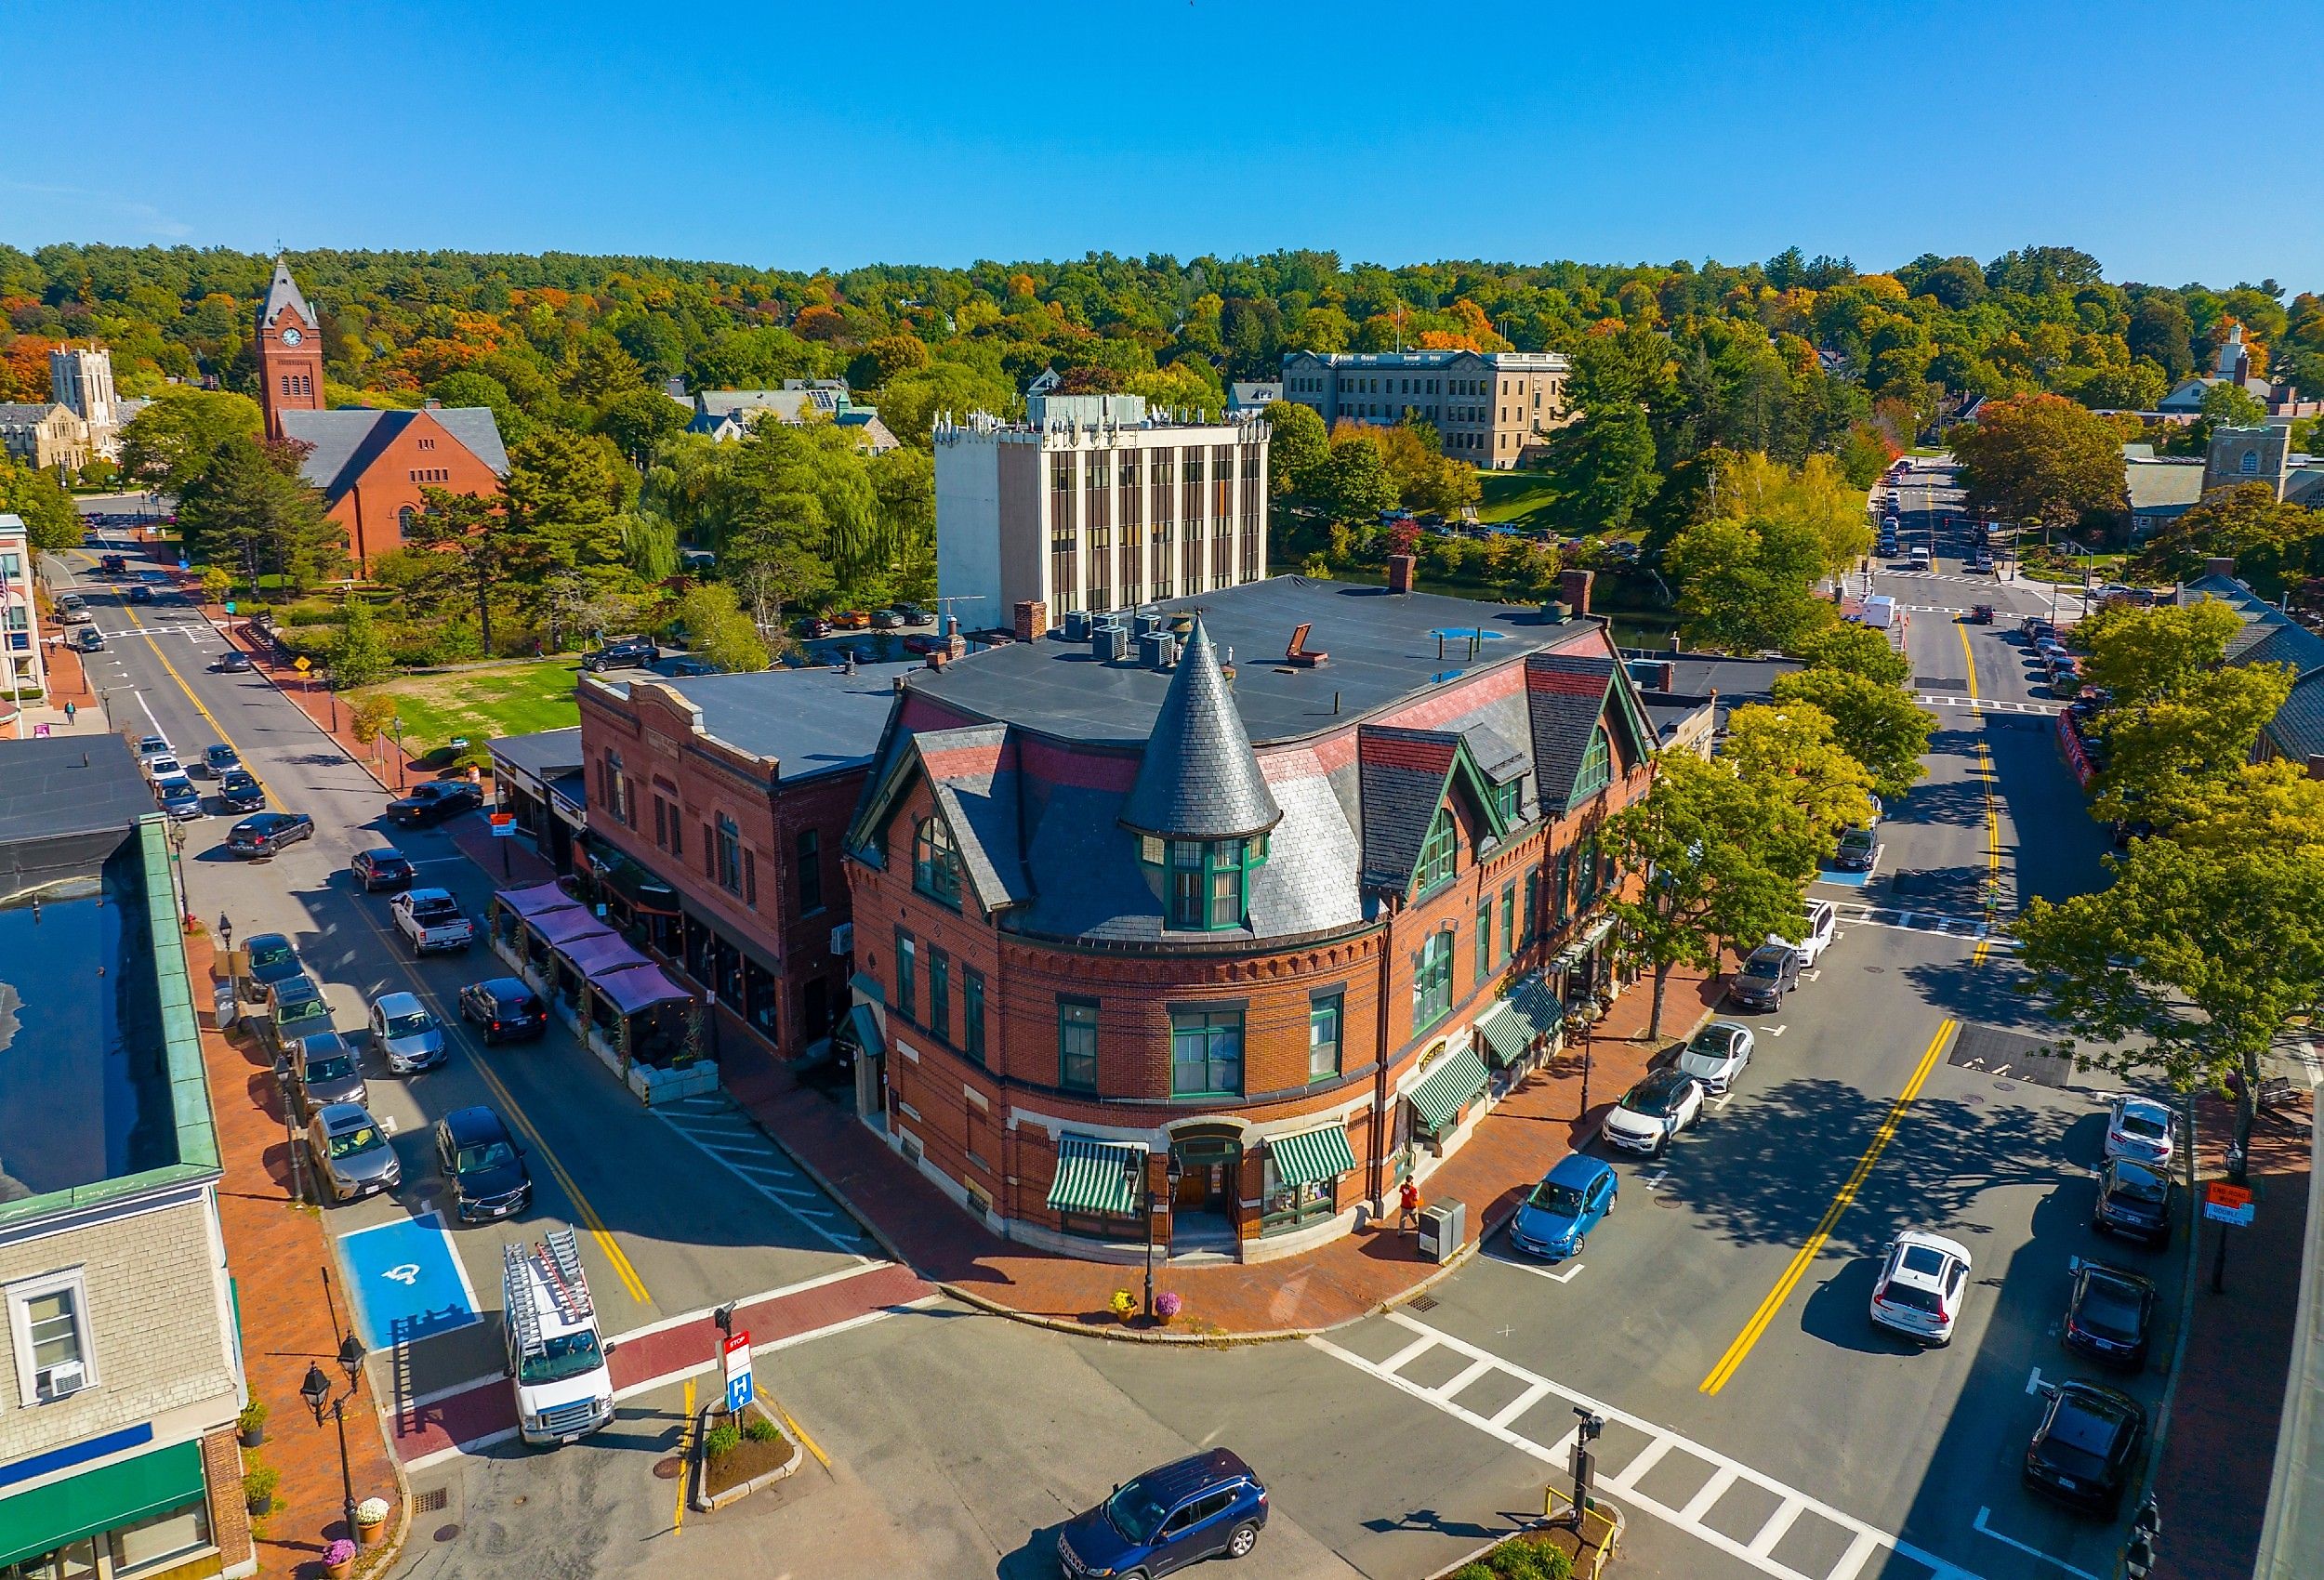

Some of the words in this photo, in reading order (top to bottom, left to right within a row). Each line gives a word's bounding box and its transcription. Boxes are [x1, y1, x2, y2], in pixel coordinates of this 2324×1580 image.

[2212, 1187, 2225, 1195] END
[2228, 1191, 2245, 1199] ROAD
[2219, 1196, 2238, 1205] WORK
[2213, 1206, 2238, 1218] DOUBLE
[729, 1336, 745, 1348] STOP
[733, 1376, 746, 1397] H
